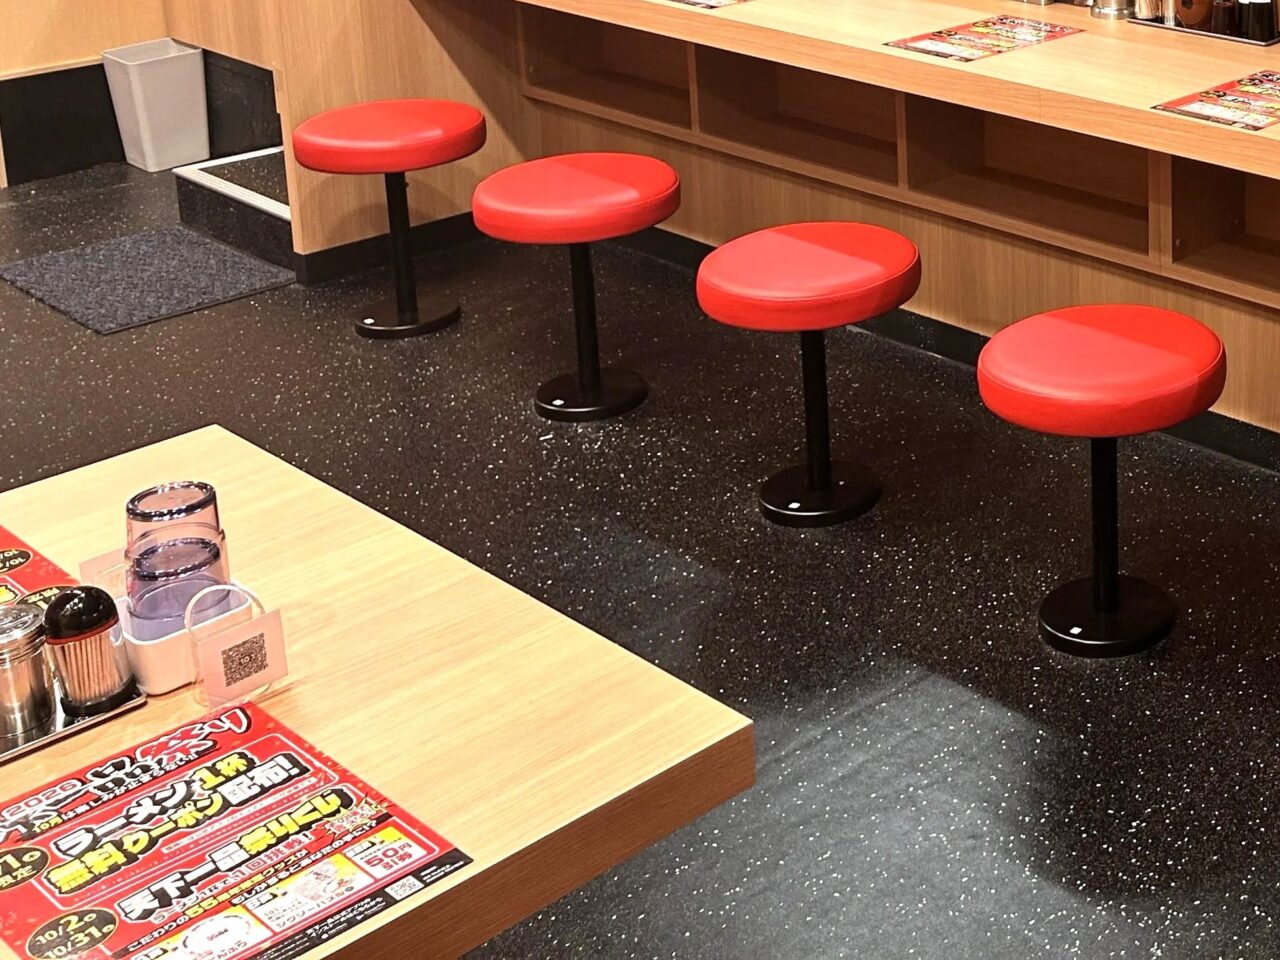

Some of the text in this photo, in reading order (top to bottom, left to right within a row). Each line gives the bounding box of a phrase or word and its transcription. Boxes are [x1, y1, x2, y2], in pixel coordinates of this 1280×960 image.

[54, 752, 249, 857] ラーメン1杯
[118, 790, 342, 920] 天下一品祭りくじ
